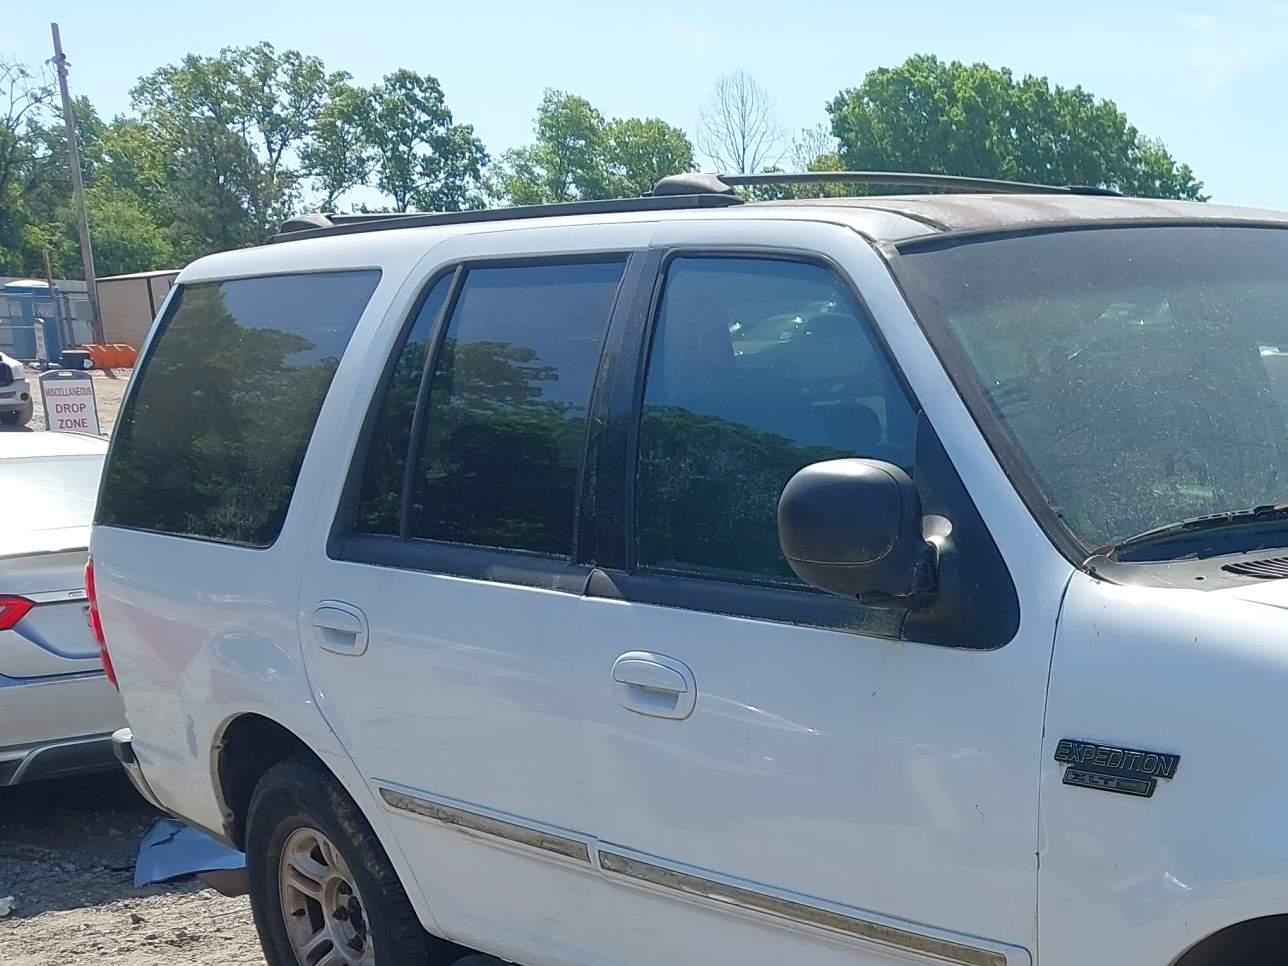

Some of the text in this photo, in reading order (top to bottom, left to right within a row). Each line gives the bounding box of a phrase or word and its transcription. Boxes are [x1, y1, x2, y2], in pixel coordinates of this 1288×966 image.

[46, 386, 92, 397] MISCELLANEOUS
[55, 403, 86, 414] DROP
[58, 418, 88, 430] ZONE
[1055, 740, 1175, 777] EXPEDITION
